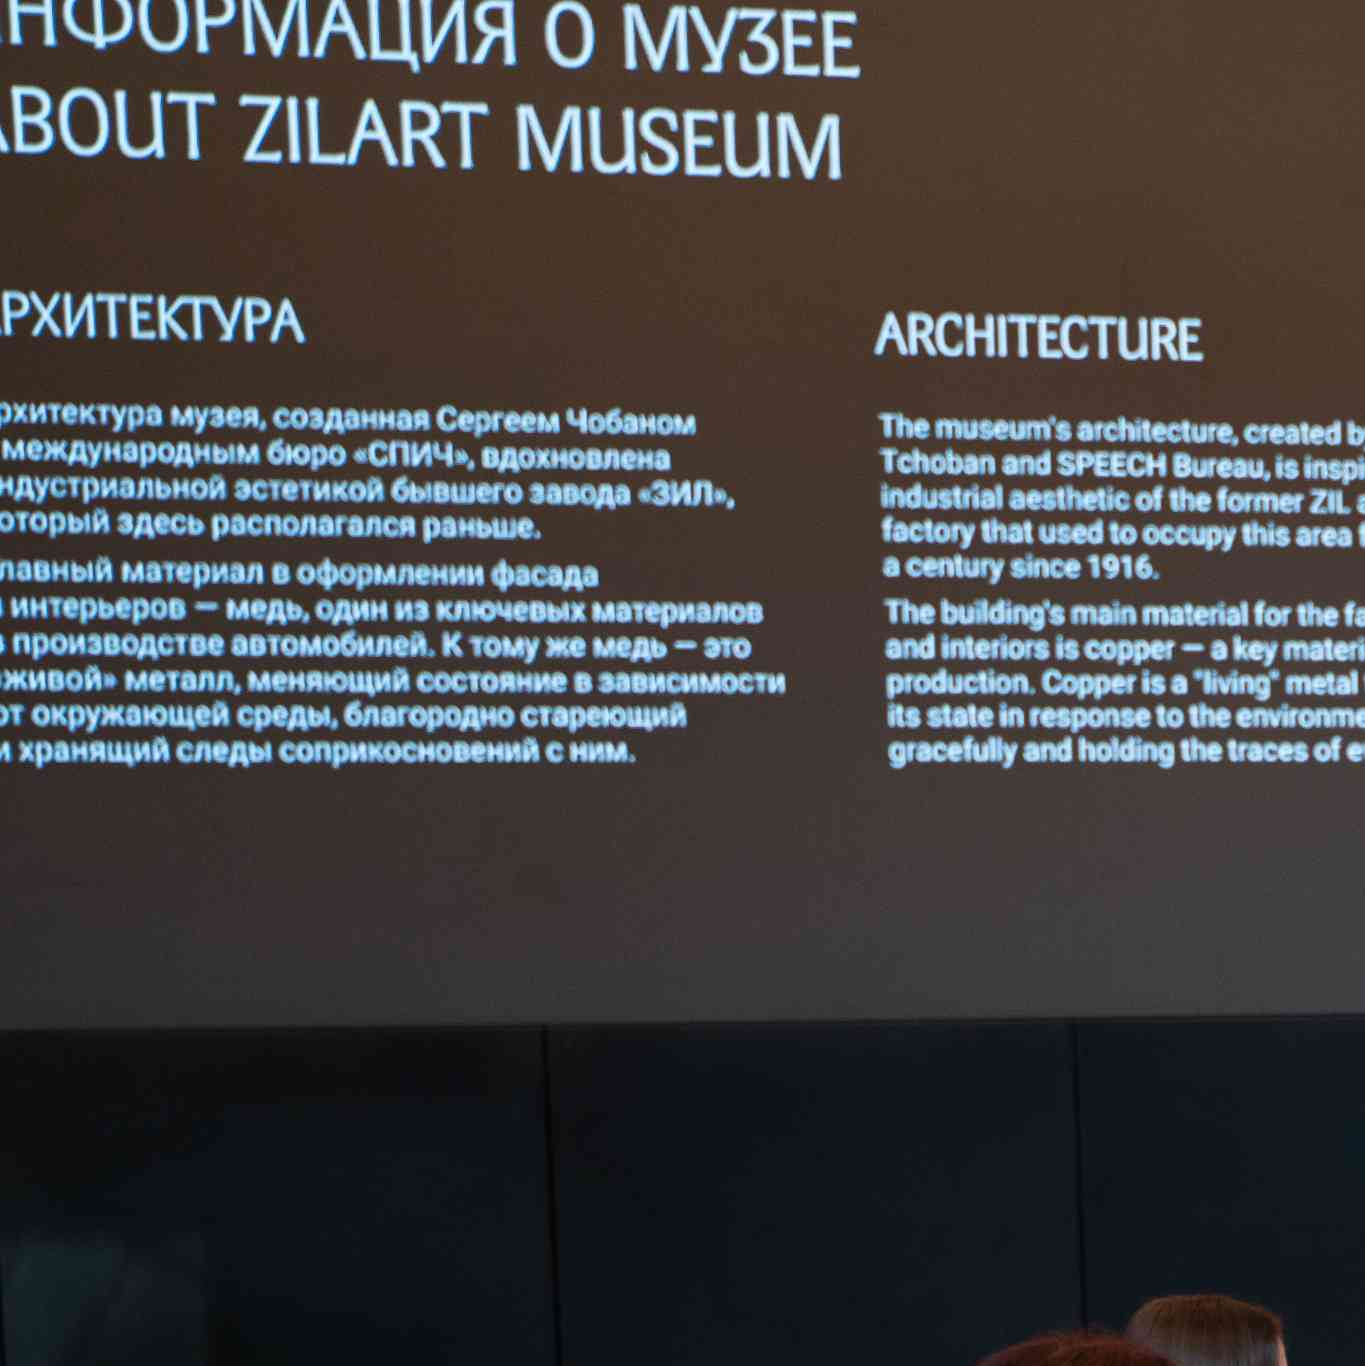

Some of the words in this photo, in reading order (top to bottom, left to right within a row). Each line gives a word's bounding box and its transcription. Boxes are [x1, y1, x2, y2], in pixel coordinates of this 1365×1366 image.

[0, 0, 517, 74] НФОРМАЦИЯ
[544, 0, 595, 69] О
[622, 2, 861, 78] МУЗЕЕ
[0, 84, 217, 160] BOUT
[239, 93, 490, 169] ZILART
[515, 103, 842, 180] MUSEUM
[0, 289, 306, 343] РХИТЕКТУРА
[874, 311, 1204, 362] ARCHITECTURE
[170, 405, 267, 434] музея,
[272, 406, 431, 435] созданная
[436, 404, 560, 438] Сергеем
[566, 407, 696, 436] Чобаном
[878, 412, 930, 440] The
[935, 416, 1072, 442] museum's
[1076, 416, 1239, 447] architecture,
[1243, 420, 1342, 446] created
[2, 438, 261, 469] международным
[266, 437, 347, 471] бюро
[481, 446, 671, 474] вдохновлена
[879, 447, 996, 475] Tchoban
[1001, 449, 1052, 476] and
[1056, 450, 1167, 477] SPEECH
[1172, 452, 1271, 482] Bureau,
[1275, 454, 1300, 479] is
[234, 475, 385, 502] эстетикой
[390, 475, 524, 505] бывшего
[529, 481, 631, 510] завода
[880, 482, 1003, 510] industrial
[1008, 485, 1131, 512] aesthetic
[1134, 485, 1164, 513] of
[1168, 486, 1212, 513] the
[1216, 485, 1305, 514] former
[1309, 488, 1352, 514] ZIL
[0, 507, 110, 539] оторый
[117, 512, 205, 539] здесь
[211, 513, 416, 542] располагался
[422, 515, 541, 543] раньше.
[881, 515, 976, 550] factory
[980, 517, 1034, 544] that
[1038, 518, 1104, 545] used
[1108, 521, 1138, 546] to
[1142, 523, 1237, 552] occupy
[1241, 520, 1291, 547] this
[1295, 525, 1353, 548] area
[121, 561, 264, 590] материал
[271, 561, 291, 585] в
[296, 557, 485, 592] оформлении
[490, 558, 599, 592] фасада
[882, 556, 900, 577] a
[904, 553, 1005, 584] century
[1010, 553, 1082, 580] since
[1087, 553, 1160, 580] 1916.
[10, 596, 186, 625] интерьеров
[226, 598, 310, 625] медь,
[314, 598, 388, 626] один
[394, 599, 430, 622] из
[435, 600, 587, 623] ключевых
[591, 601, 764, 629] материалов
[884, 598, 936, 624] The
[940, 598, 1065, 632] building's
[1070, 600, 1137, 626] main
[1142, 600, 1249, 627] material
[1253, 599, 1292, 628] for
[1296, 601, 1340, 627] the
[12, 632, 224, 661] производстве
[231, 629, 436, 658] автомобилей.
[442, 630, 464, 657] К
[469, 635, 540, 665] тому
[545, 635, 586, 658] же
[592, 636, 668, 662] медь
[703, 636, 752, 660] это
[885, 633, 936, 660] and
[941, 633, 1050, 661] interiors
[1055, 634, 1080, 661] is
[1083, 639, 1176, 666] copper
[1210, 639, 1228, 661] a
[1232, 634, 1278, 667] key
[0, 664, 117, 692] живой»
[124, 669, 242, 695] металл,
[247, 666, 410, 697] меняющий
[416, 671, 568, 694] состояние
[573, 671, 593, 694] в
[598, 671, 786, 695] зависимости
[886, 667, 1036, 700] production.
[1041, 668, 1137, 701] Copper
[1141, 669, 1166, 696] is
[1170, 674, 1188, 695] a
[1285, 669, 1359, 695] metal
[31, 700, 230, 733] окружающей
[236, 704, 339, 732] среды,
[343, 700, 515, 733] благородно
[520, 701, 687, 733] стареющий
[887, 702, 922, 729] its
[926, 703, 994, 728] state
[999, 702, 1024, 728] in
[1029, 706, 1152, 733] response
[1155, 703, 1184, 728] to
[1188, 703, 1232, 729] the
[19, 736, 170, 768] хранящий
[176, 740, 272, 768] следы
[278, 736, 540, 769] соприкосновений
[544, 741, 564, 764] с
[569, 741, 636, 763] ним.
[888, 735, 1018, 769] gracefully
[1022, 735, 1073, 763] and
[1078, 735, 1175, 769] holding
[1179, 736, 1224, 762] the
[1226, 739, 1309, 763] traces
[1312, 736, 1342, 763] of
